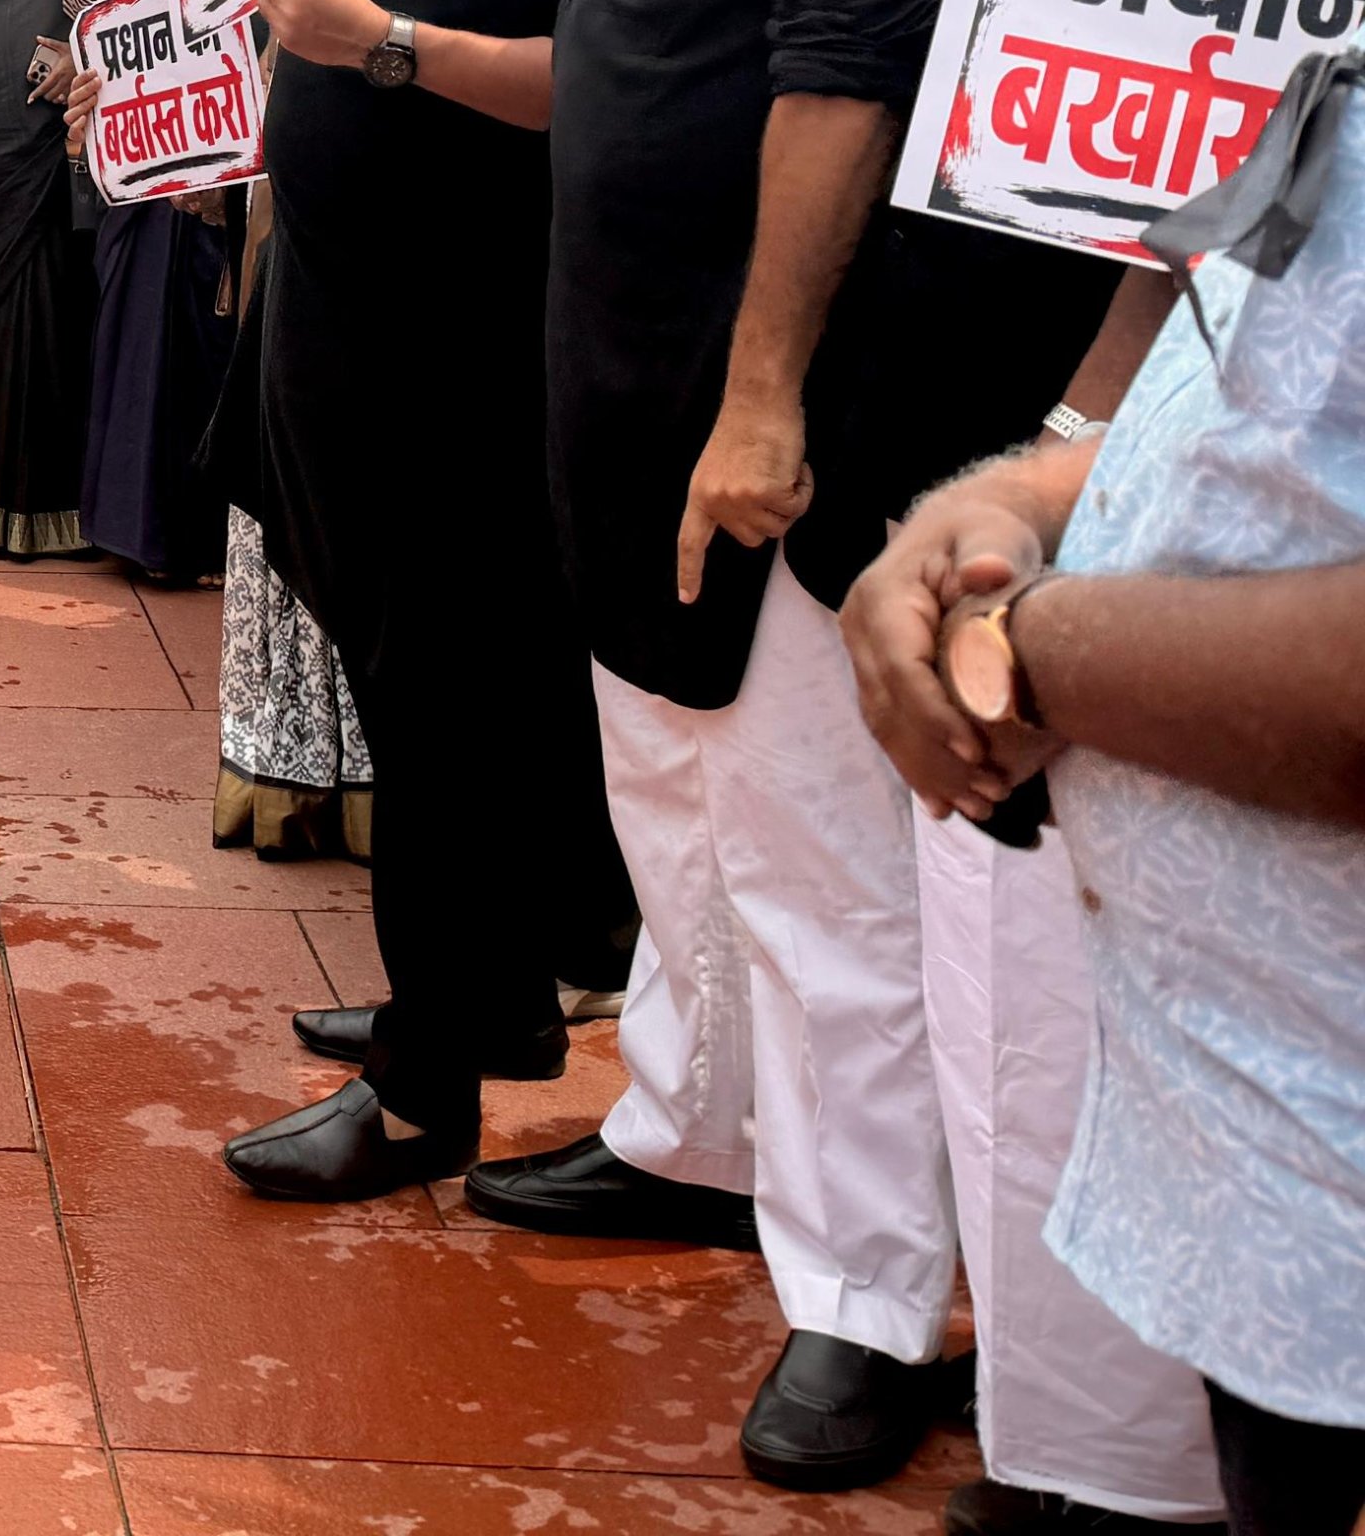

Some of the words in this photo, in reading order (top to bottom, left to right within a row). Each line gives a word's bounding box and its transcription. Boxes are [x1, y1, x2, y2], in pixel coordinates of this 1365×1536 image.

[95, 10, 178, 82] प्रधान
[100, 74, 189, 167] बर्खास्त
[186, 52, 250, 147] करो
